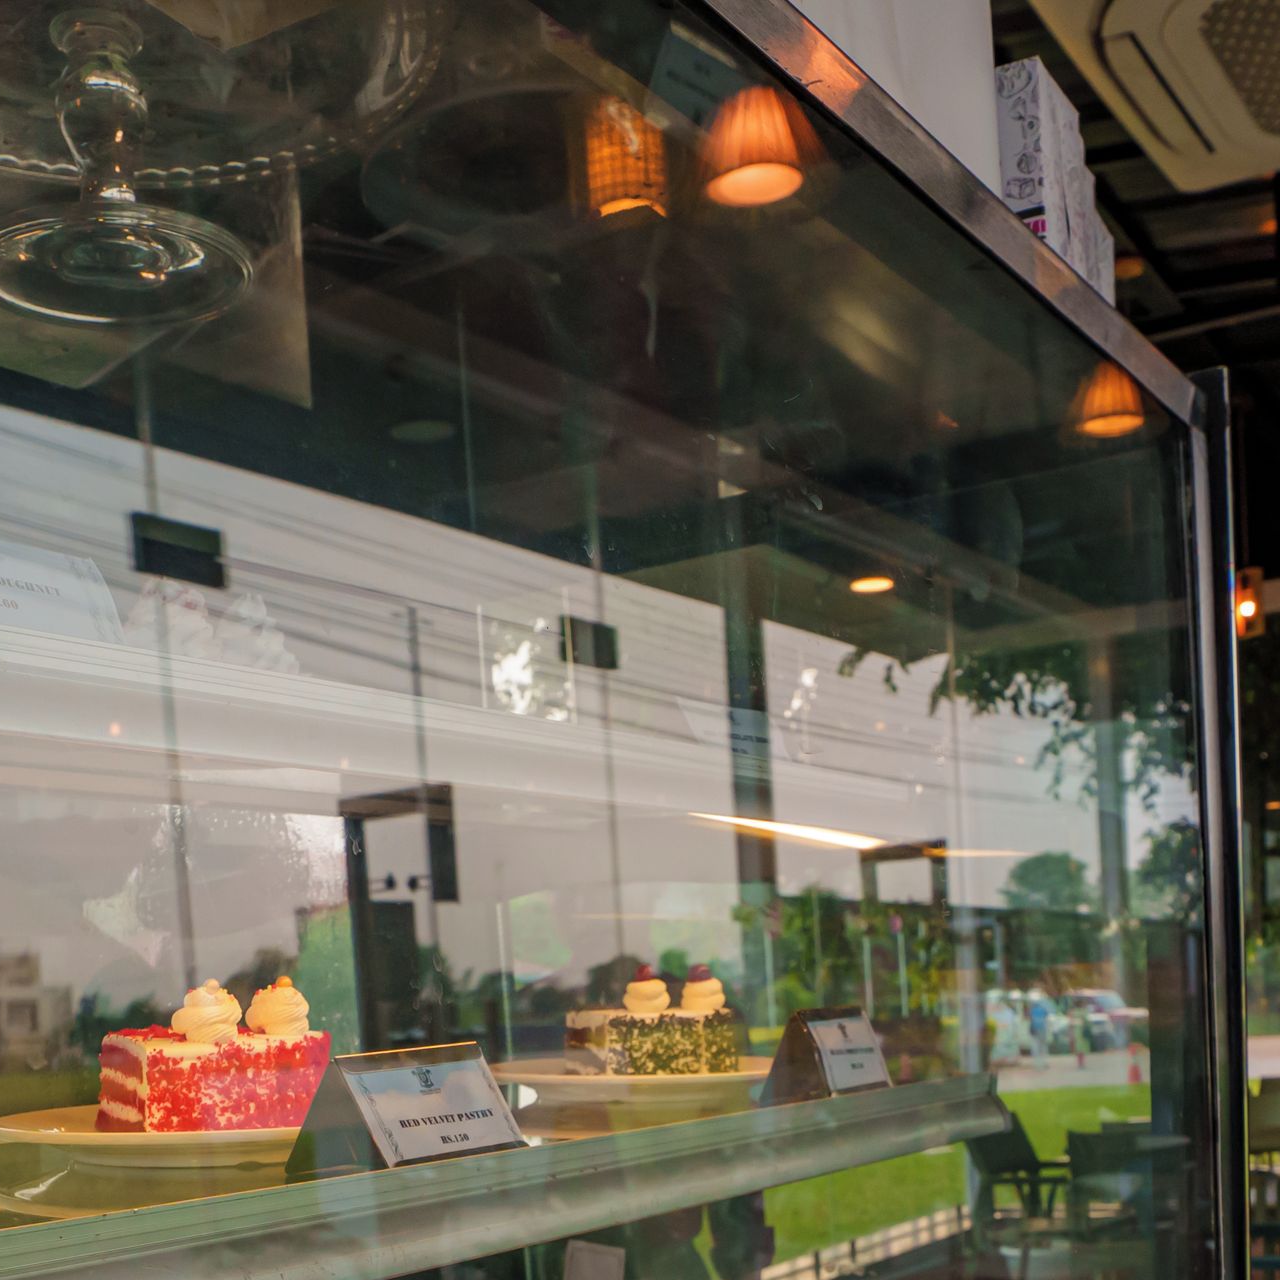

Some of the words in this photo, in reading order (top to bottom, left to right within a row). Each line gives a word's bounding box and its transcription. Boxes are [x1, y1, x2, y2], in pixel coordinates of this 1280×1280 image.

[399, 1119, 421, 1129] RED
[421, 1113, 457, 1126] VELVET
[457, 1108, 494, 1121] PASTRY
[440, 1133, 470, 1145] RS.150
